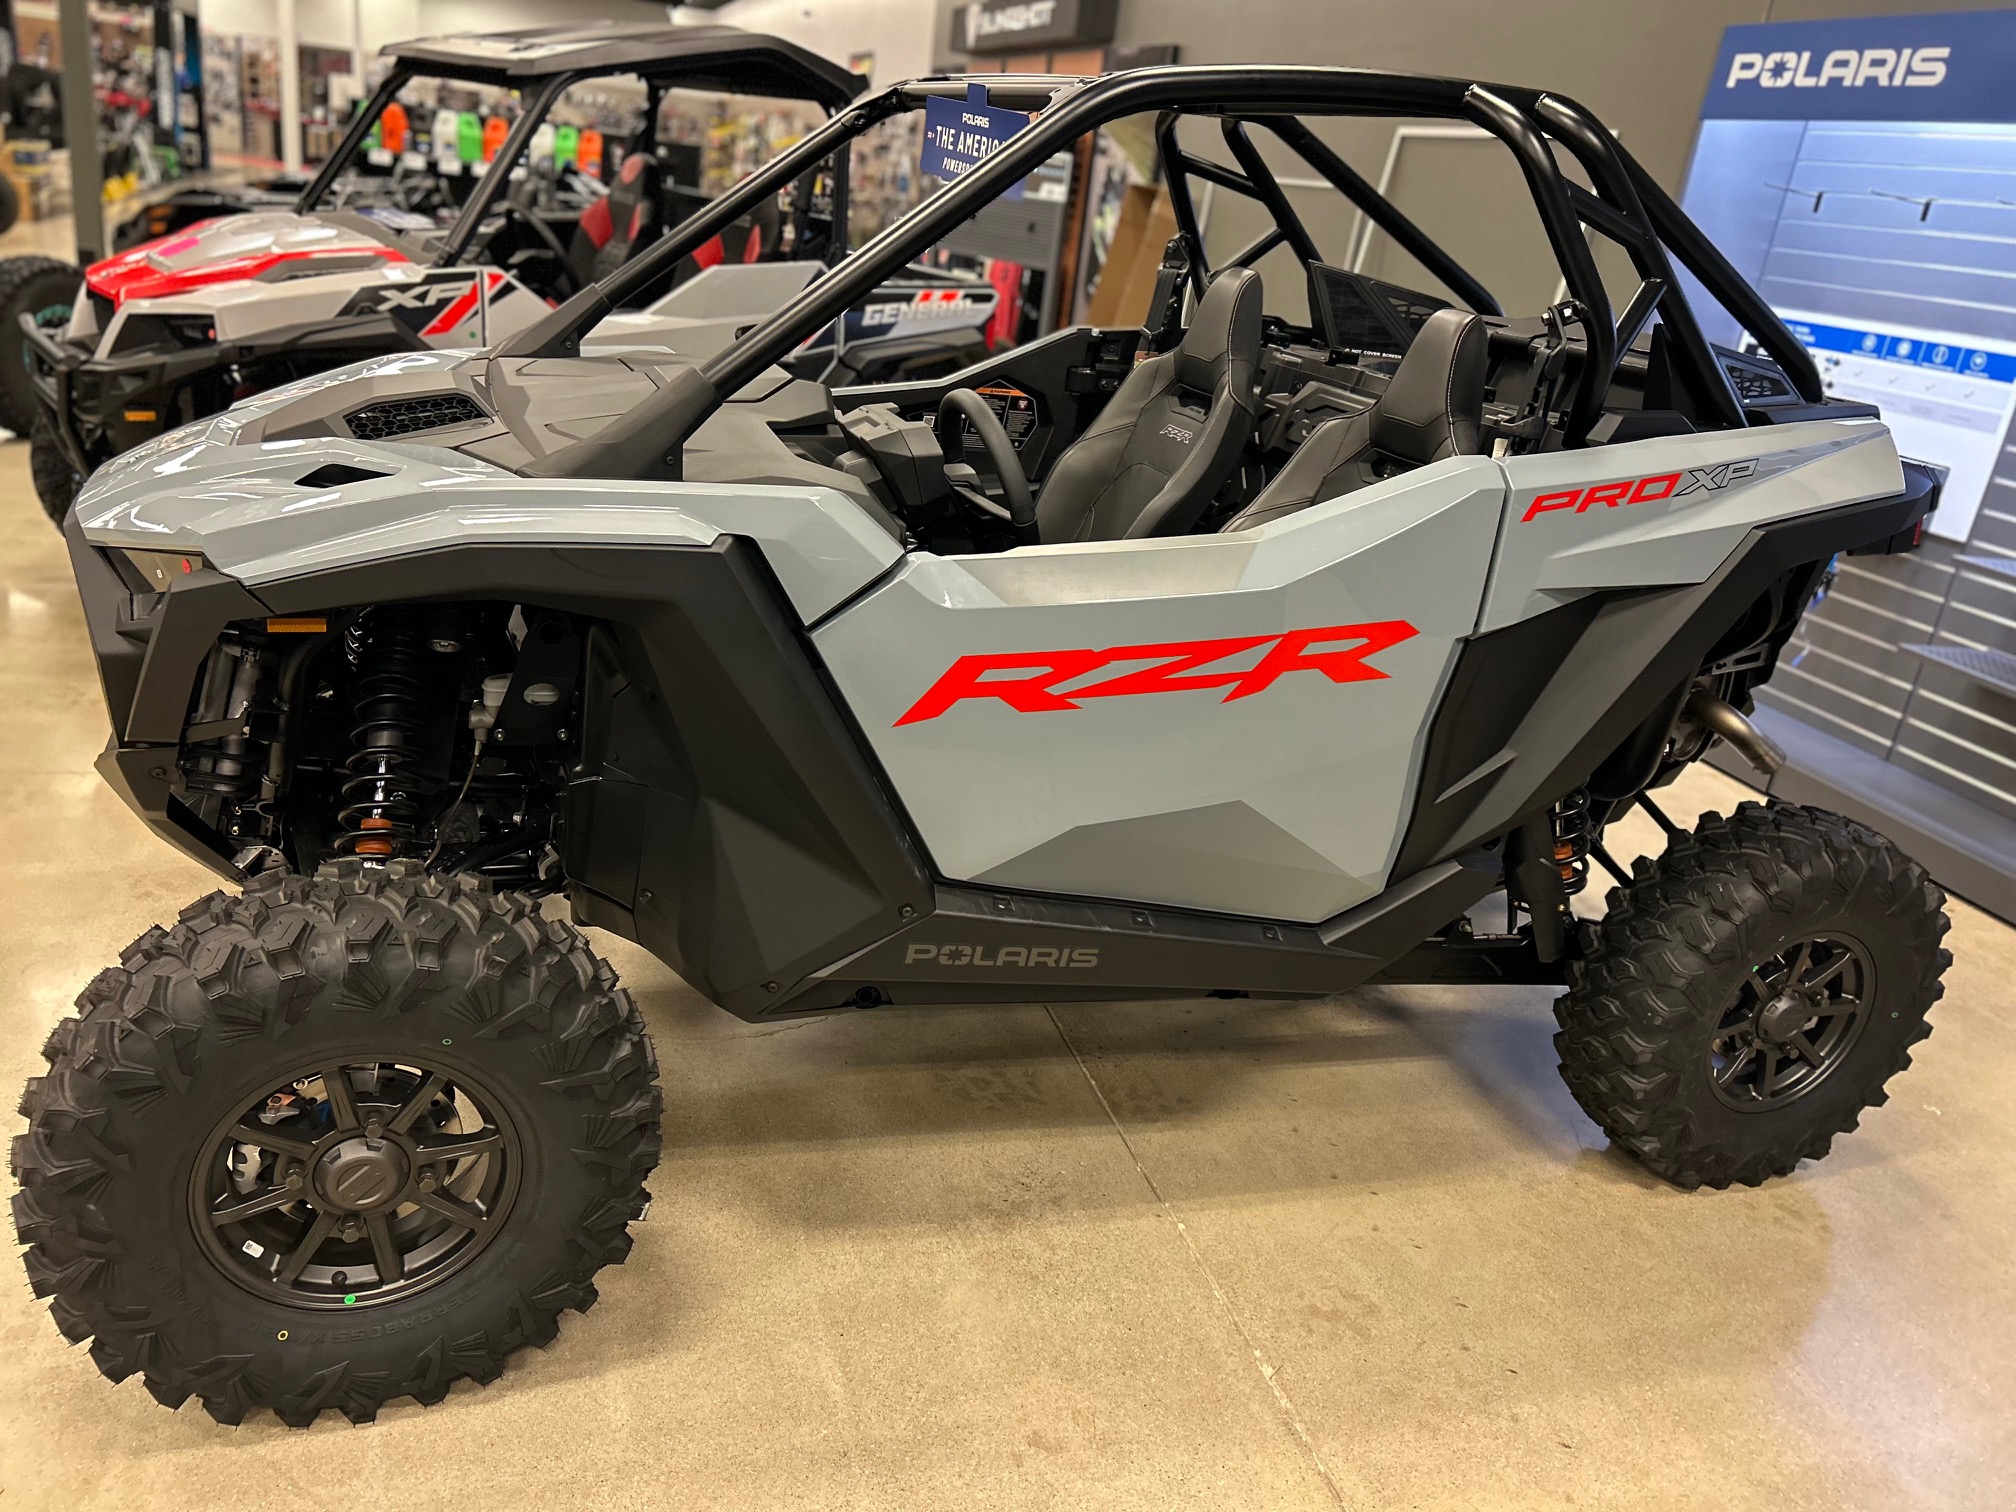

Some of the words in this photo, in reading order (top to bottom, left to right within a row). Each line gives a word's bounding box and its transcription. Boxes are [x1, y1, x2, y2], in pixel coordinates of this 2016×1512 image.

[1726, 47, 1951, 88] POLARIS
[962, 112, 990, 129] POLARIS
[935, 125, 956, 151] THE
[957, 131, 1005, 158] AMERIC
[376, 280, 474, 311] XP
[861, 298, 980, 327] GENERAL
[1160, 423, 1193, 444] RZR
[1520, 472, 1683, 523] PRO
[1673, 458, 1760, 497] XP
[891, 619, 1420, 728] RZR
[903, 943, 1100, 968] POLARIS
